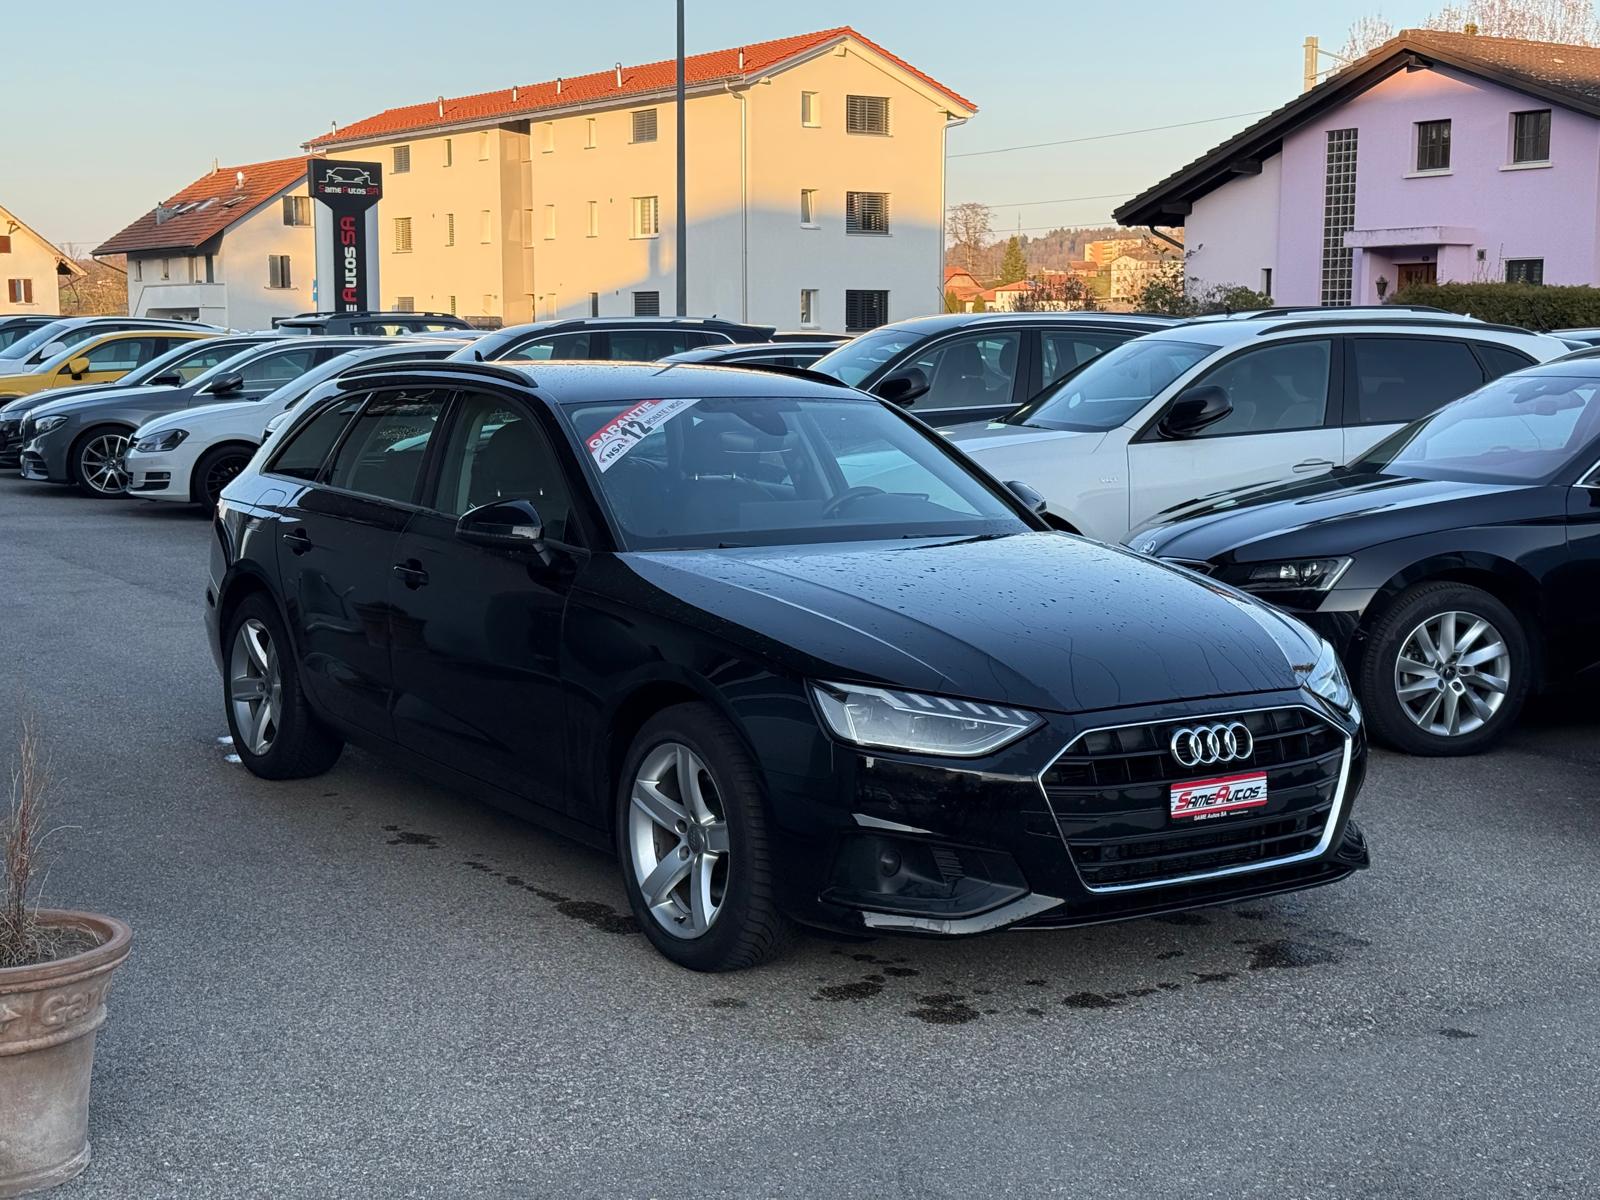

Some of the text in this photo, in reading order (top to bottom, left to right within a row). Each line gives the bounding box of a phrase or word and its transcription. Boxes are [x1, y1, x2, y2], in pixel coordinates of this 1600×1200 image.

[589, 401, 656, 449] GARANTIE
[620, 421, 654, 440] 12
[605, 443, 625, 459] NSA
